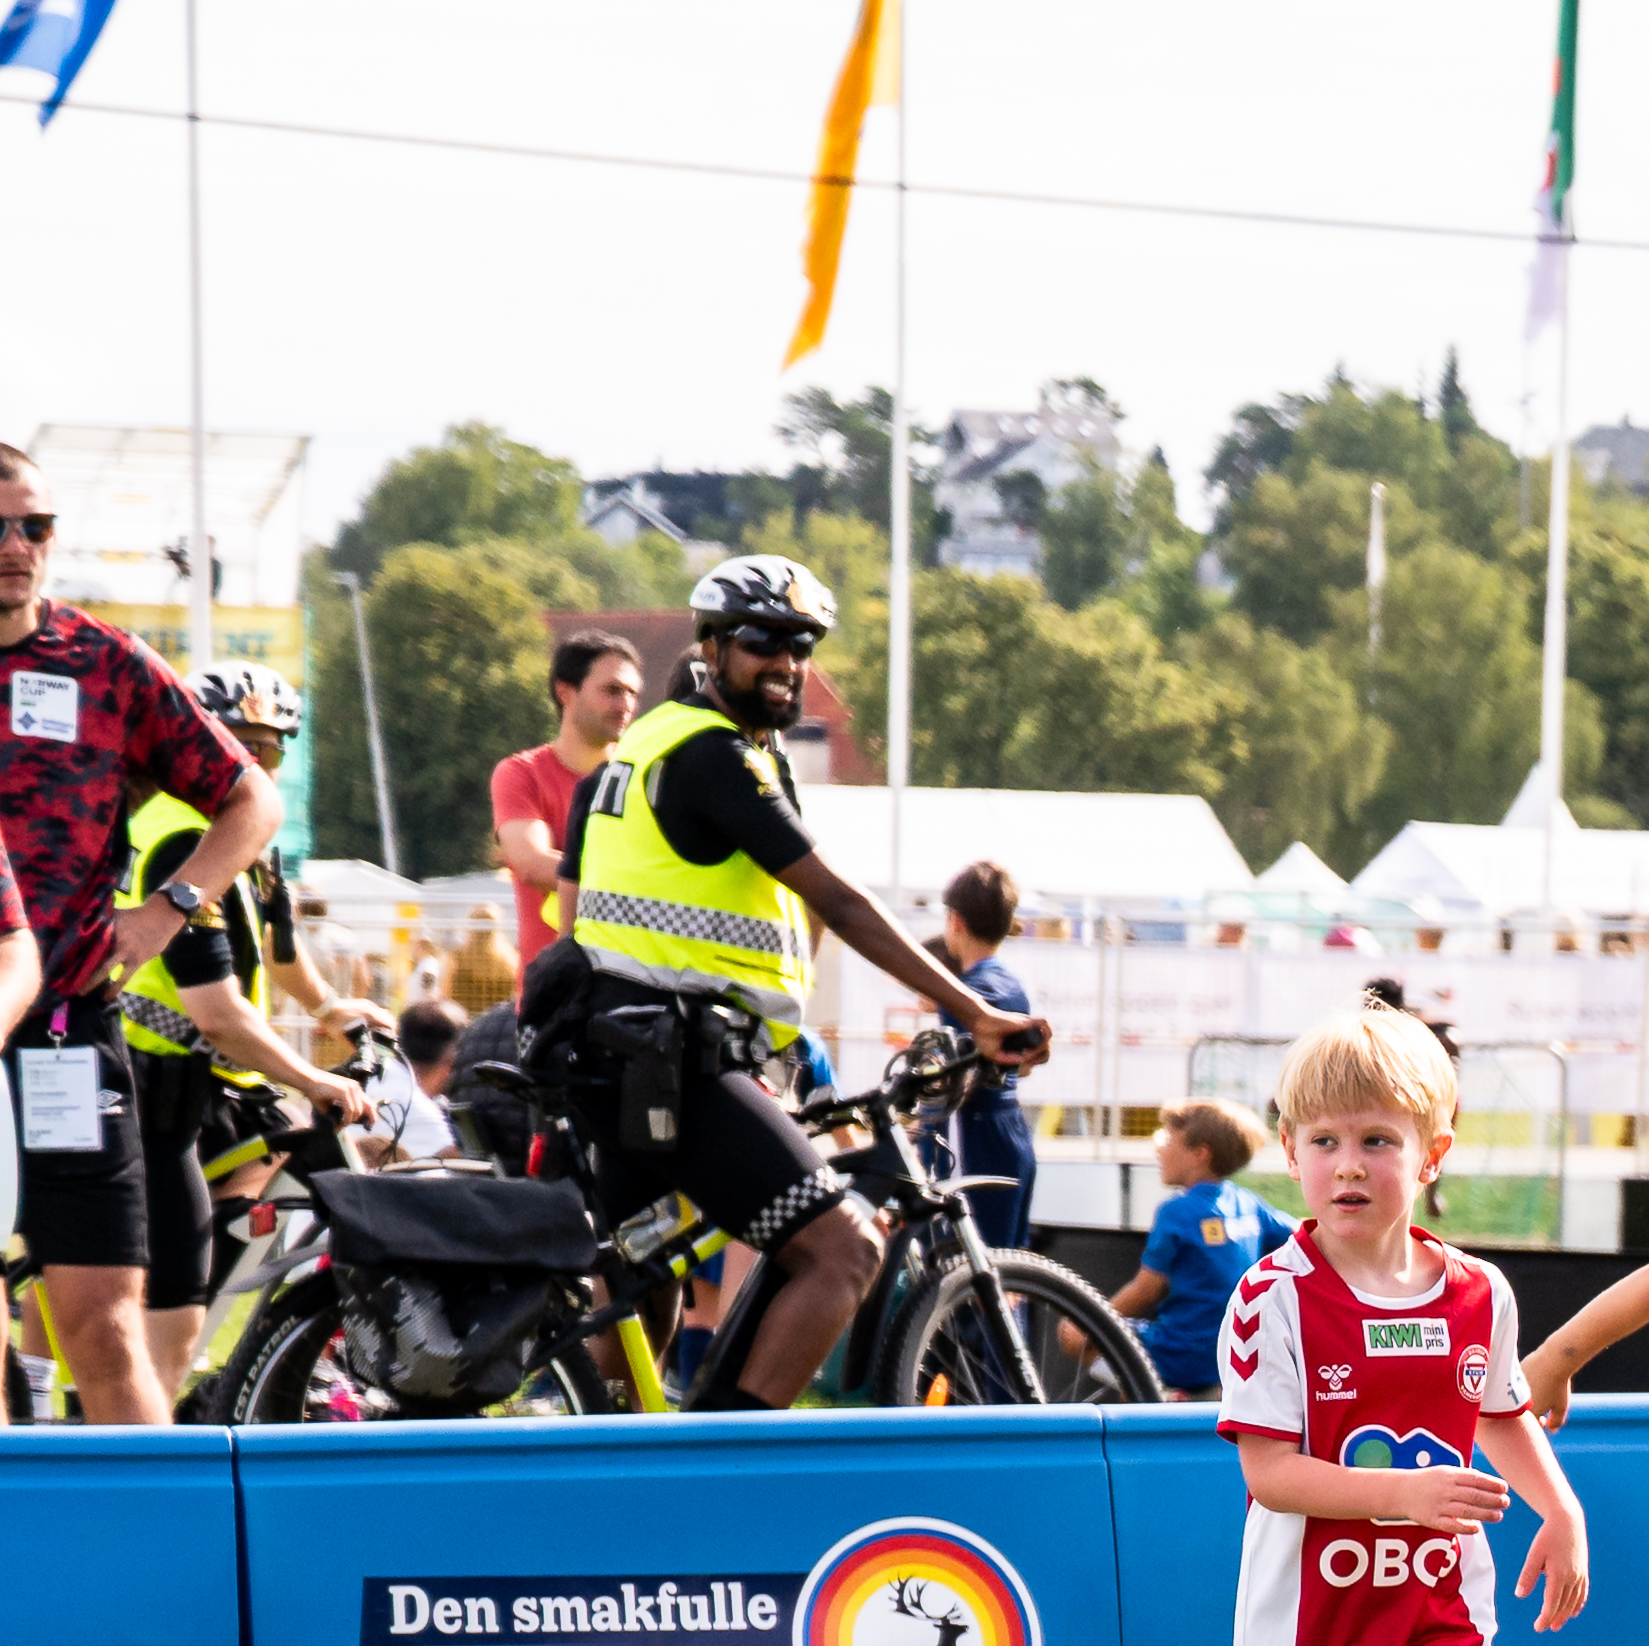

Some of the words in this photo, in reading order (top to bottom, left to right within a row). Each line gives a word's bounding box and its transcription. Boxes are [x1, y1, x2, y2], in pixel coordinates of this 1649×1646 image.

[1368, 1323, 1423, 1349] KIWI
[1424, 1323, 1445, 1337] mini
[1425, 1335, 1445, 1351] pris
[1316, 1388, 1357, 1401] hummel
[1319, 1537, 1458, 1588] OBO
[388, 1584, 499, 1635] Den
[512, 1581, 779, 1633] smakfulle
